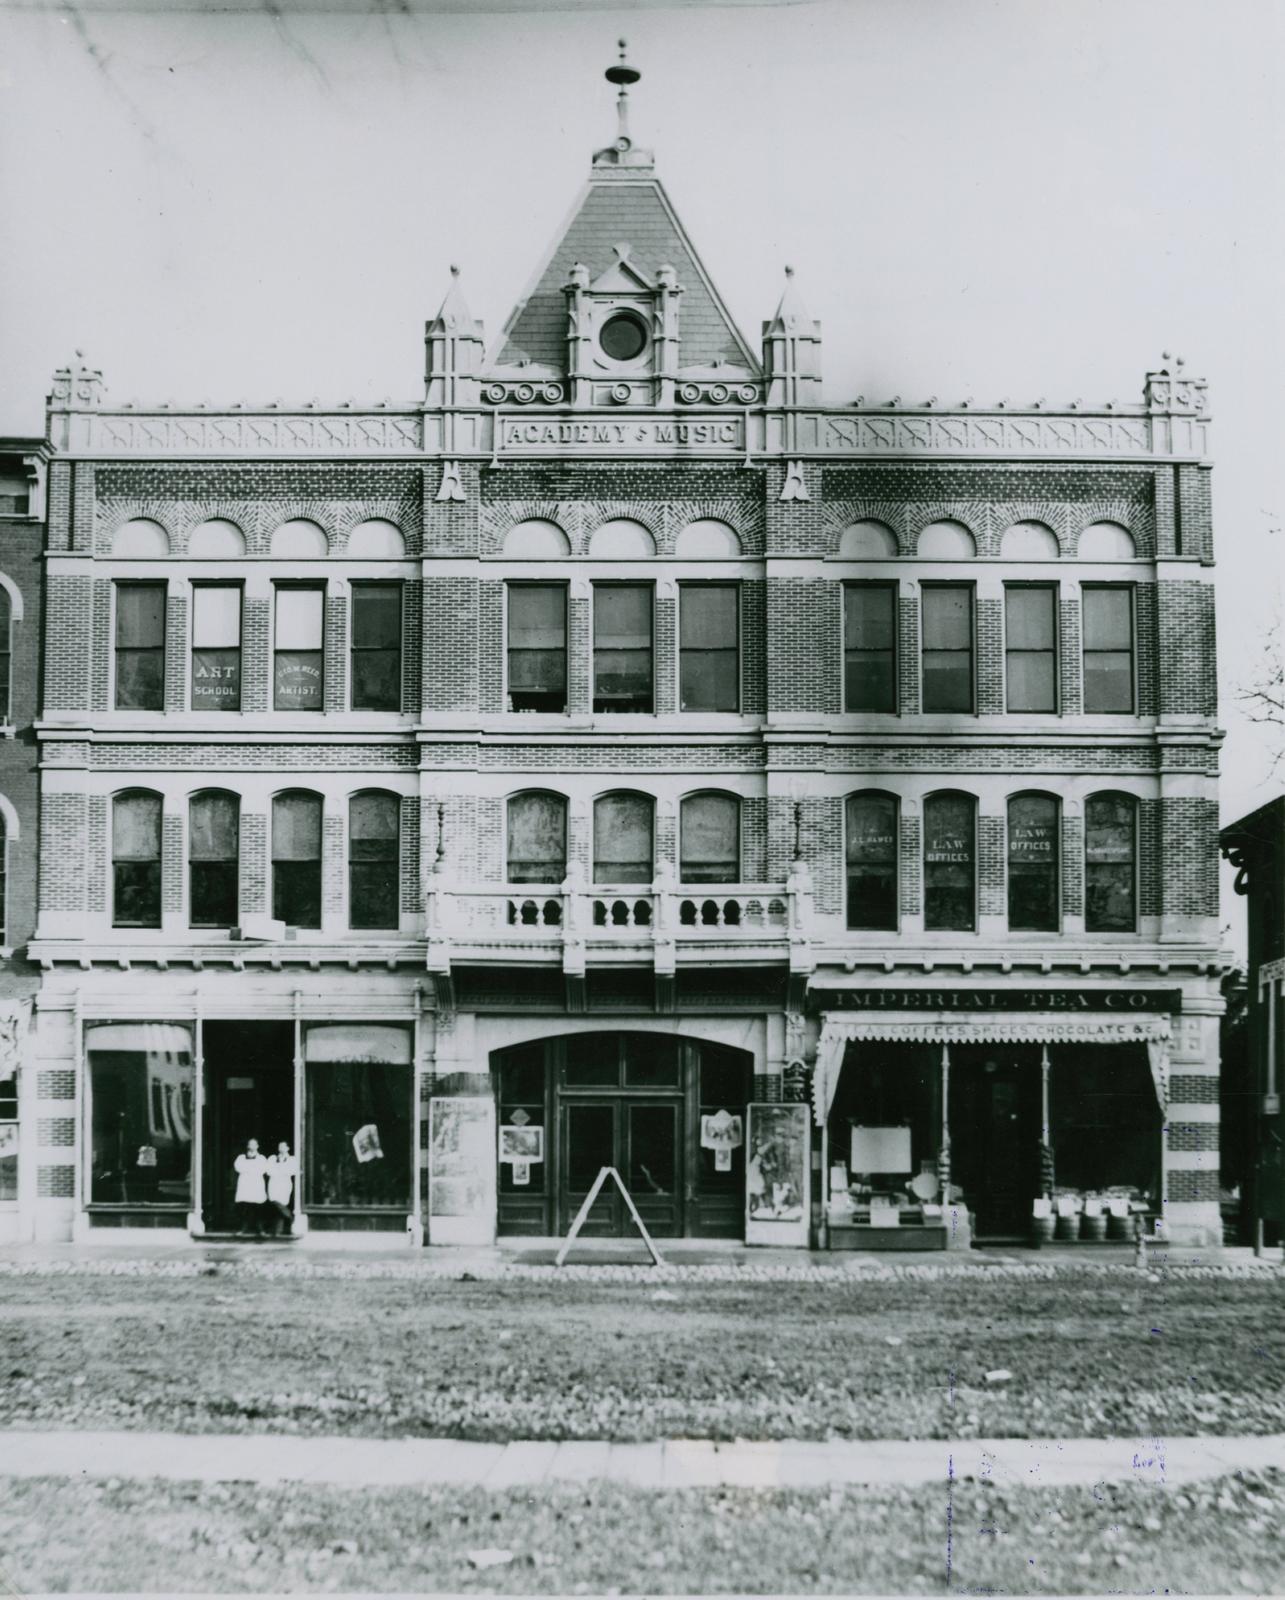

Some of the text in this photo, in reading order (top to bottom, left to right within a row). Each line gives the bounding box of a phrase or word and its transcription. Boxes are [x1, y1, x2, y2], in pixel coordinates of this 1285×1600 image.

[507, 425, 627, 444] ACADEMY
[655, 425, 735, 444] MUSIC
[195, 666, 235, 678] ART
[1015, 828, 1047, 838] LAW
[932, 839, 967, 849] LAW
[1010, 841, 1051, 851] OFFICES
[927, 852, 969, 862] OFFICES
[836, 993, 1008, 1006] IMPERIAL
[1024, 993, 1089, 1007] TEA
[890, 1025, 967, 1036] COFFEES
[973, 1025, 1029, 1036] SPICES
[1036, 1025, 1126, 1035] CHOCOLATE
